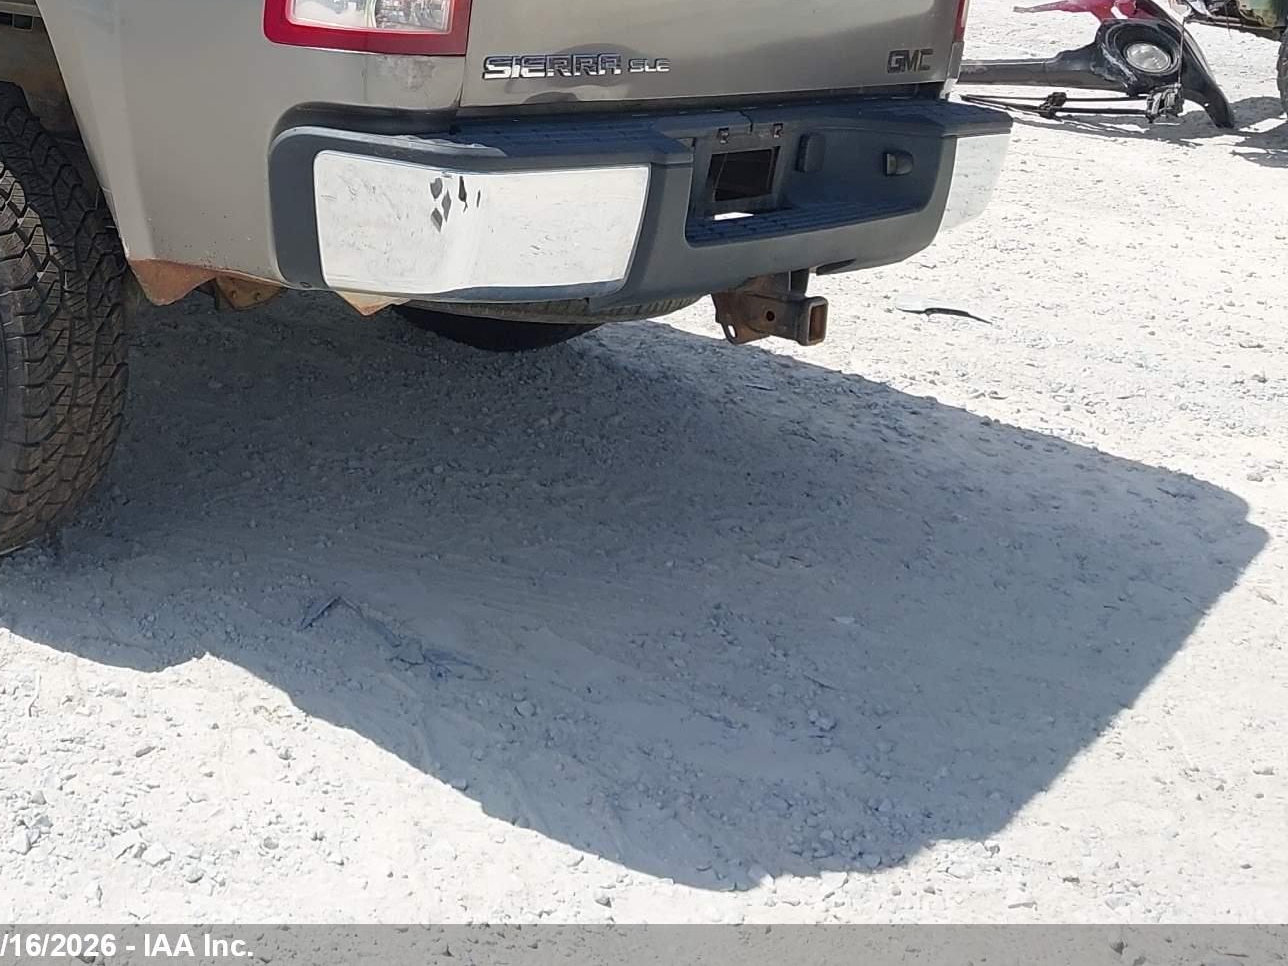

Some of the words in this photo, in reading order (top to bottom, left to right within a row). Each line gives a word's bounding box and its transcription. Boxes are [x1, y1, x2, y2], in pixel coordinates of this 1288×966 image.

[483, 54, 623, 80] SIERRA
[628, 58, 671, 73] SLE
[887, 48, 934, 74] GMC
